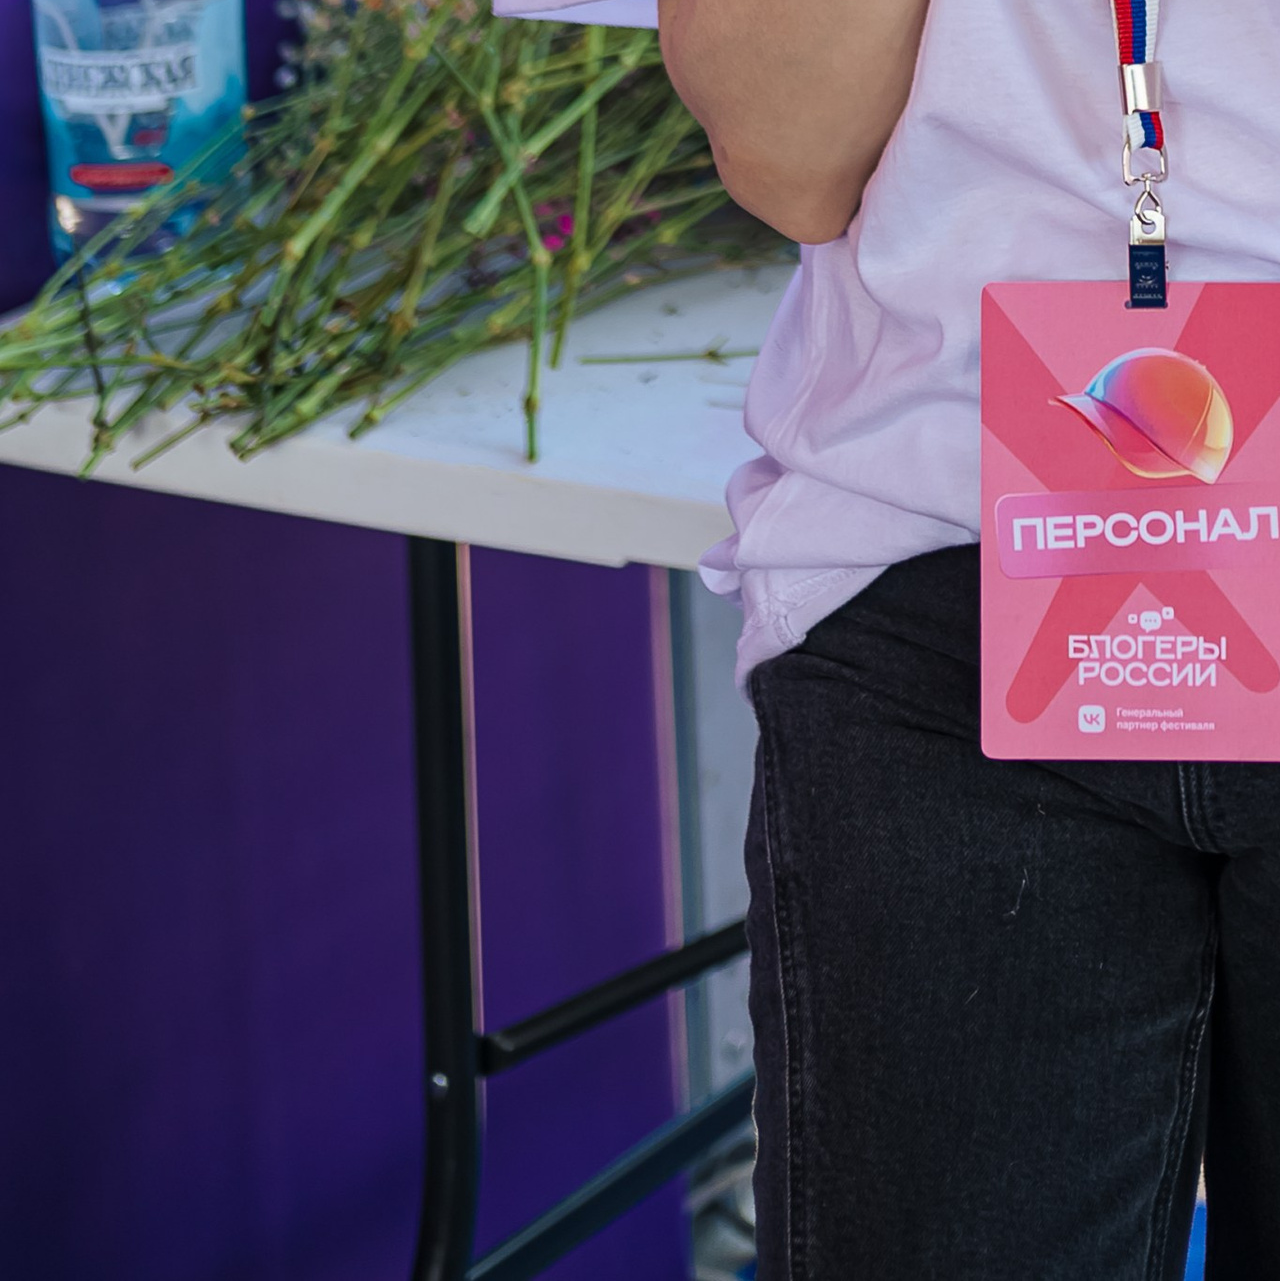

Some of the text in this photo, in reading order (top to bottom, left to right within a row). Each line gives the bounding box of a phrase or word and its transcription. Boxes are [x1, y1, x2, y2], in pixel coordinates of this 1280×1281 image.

[1011, 505, 1280, 551] ПЕРСОНАЛ
[1068, 634, 1227, 660] БЛОГЕРЫ
[1078, 661, 1217, 687] РОССИИ
[1116, 707, 1184, 719] Генеральный
[1116, 720, 1215, 732] партнер фестиваля
